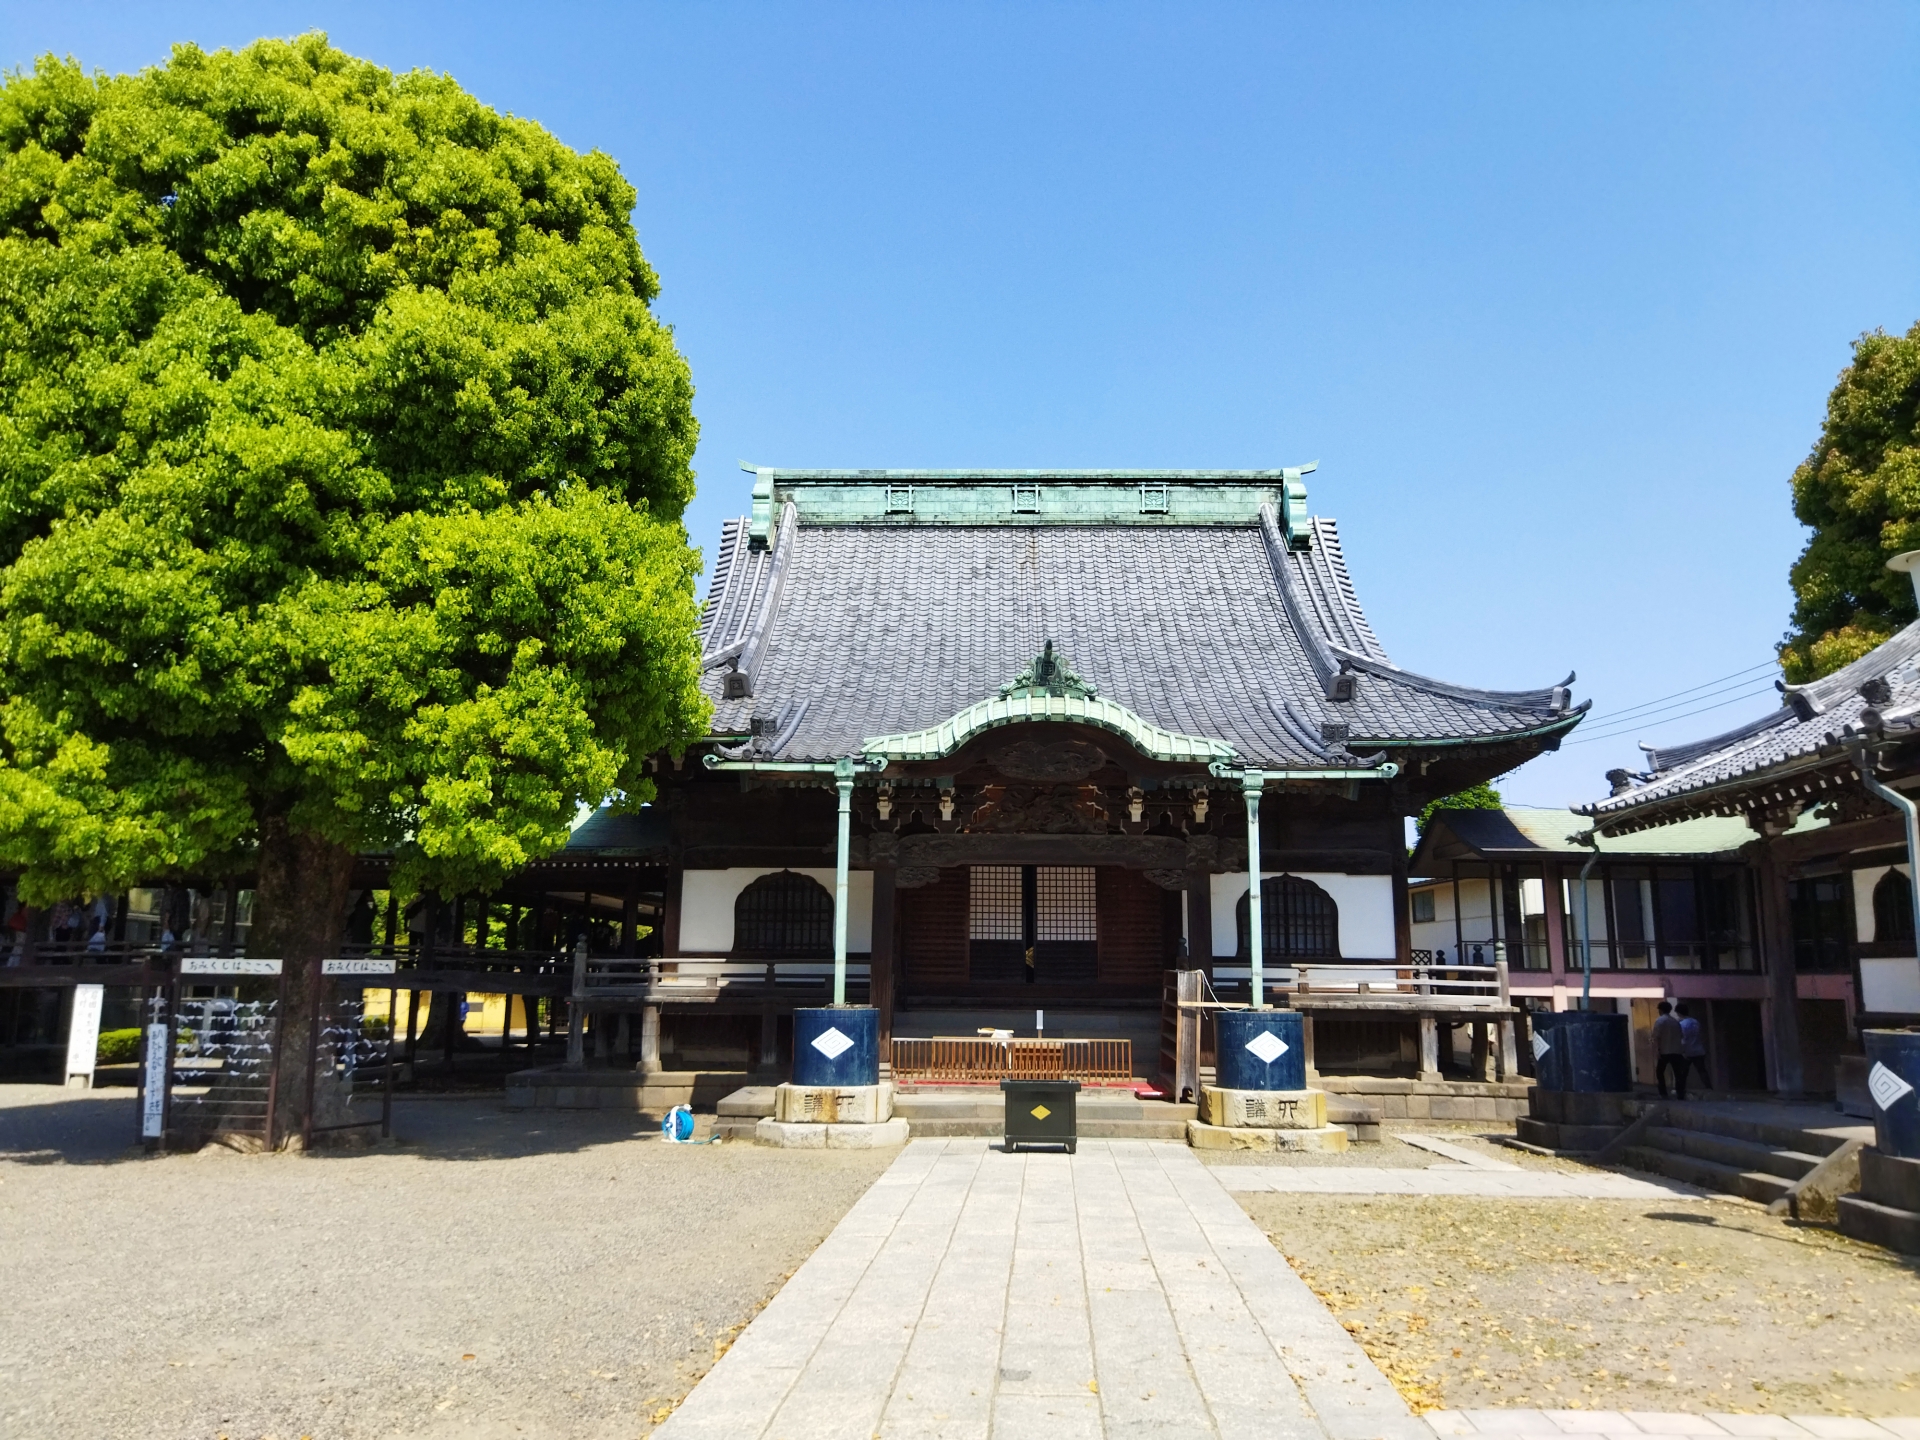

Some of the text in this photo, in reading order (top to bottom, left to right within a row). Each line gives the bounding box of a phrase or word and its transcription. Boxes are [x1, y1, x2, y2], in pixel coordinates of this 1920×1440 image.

[189, 961, 275, 971] おみくじはここへ
[326, 961, 392, 971] おみくじはここへ
